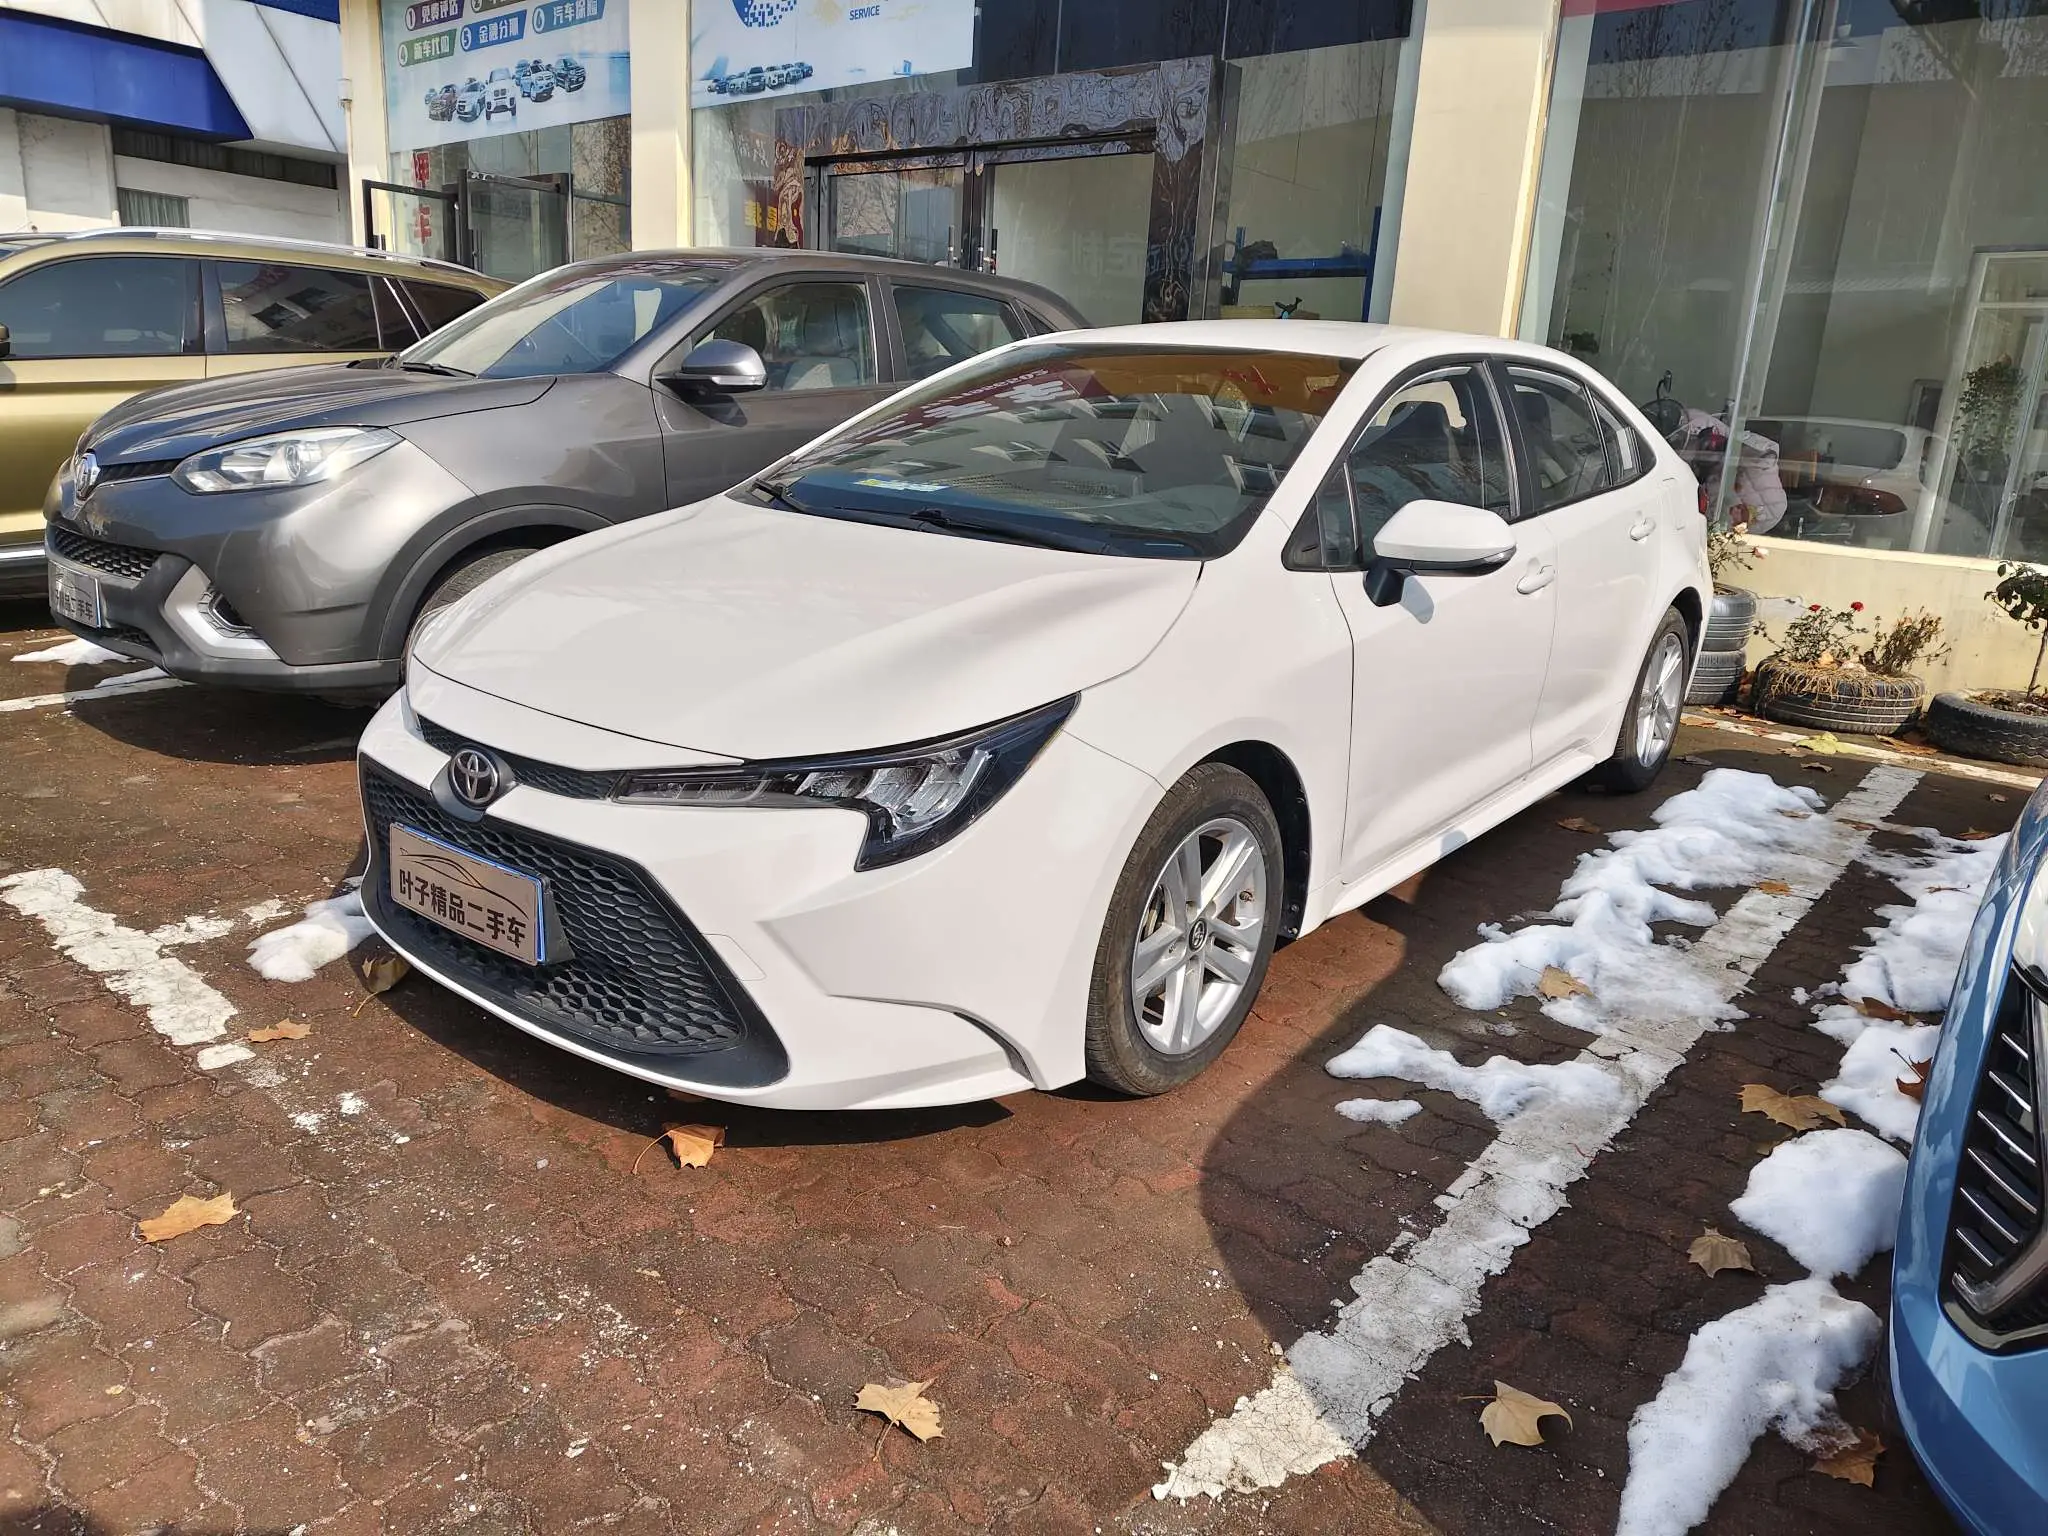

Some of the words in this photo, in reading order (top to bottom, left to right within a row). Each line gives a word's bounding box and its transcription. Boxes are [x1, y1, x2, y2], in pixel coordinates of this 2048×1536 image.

[421, 0, 458, 24] 免费评估
[849, 5, 880, 21] SERVICE
[479, 17, 519, 44] 金融分期
[399, 868, 527, 950] 叶子精品二手车
